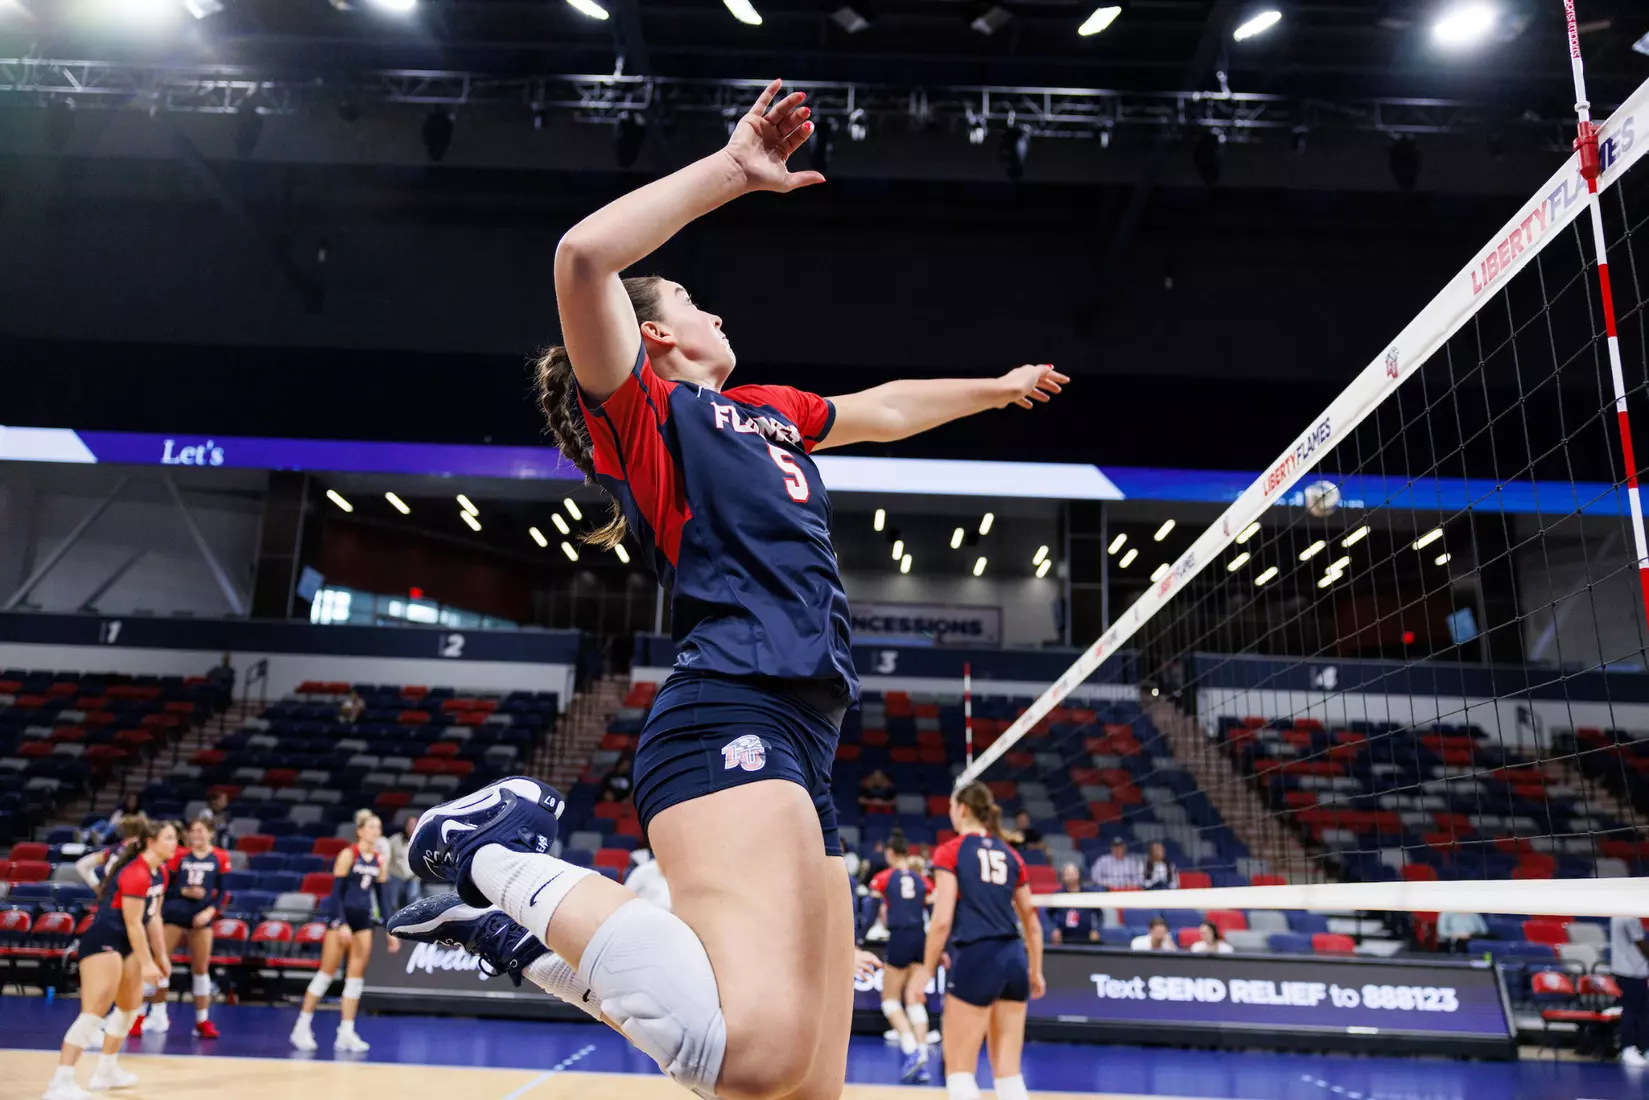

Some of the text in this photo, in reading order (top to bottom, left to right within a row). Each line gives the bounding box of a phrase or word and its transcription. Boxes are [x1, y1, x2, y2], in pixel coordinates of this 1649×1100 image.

[160, 439, 224, 467] Let's
[766, 443, 810, 503] 5
[107, 620, 122, 644] 1
[851, 615, 983, 636] NCESSIONS
[444, 633, 465, 657] 2
[876, 651, 898, 674] 3
[976, 847, 1008, 885] 15
[1090, 974, 1147, 1000] Text
[1148, 976, 1227, 1003] SEND
[1229, 979, 1327, 1007] RELIEF
[1329, 984, 1360, 1008] to
